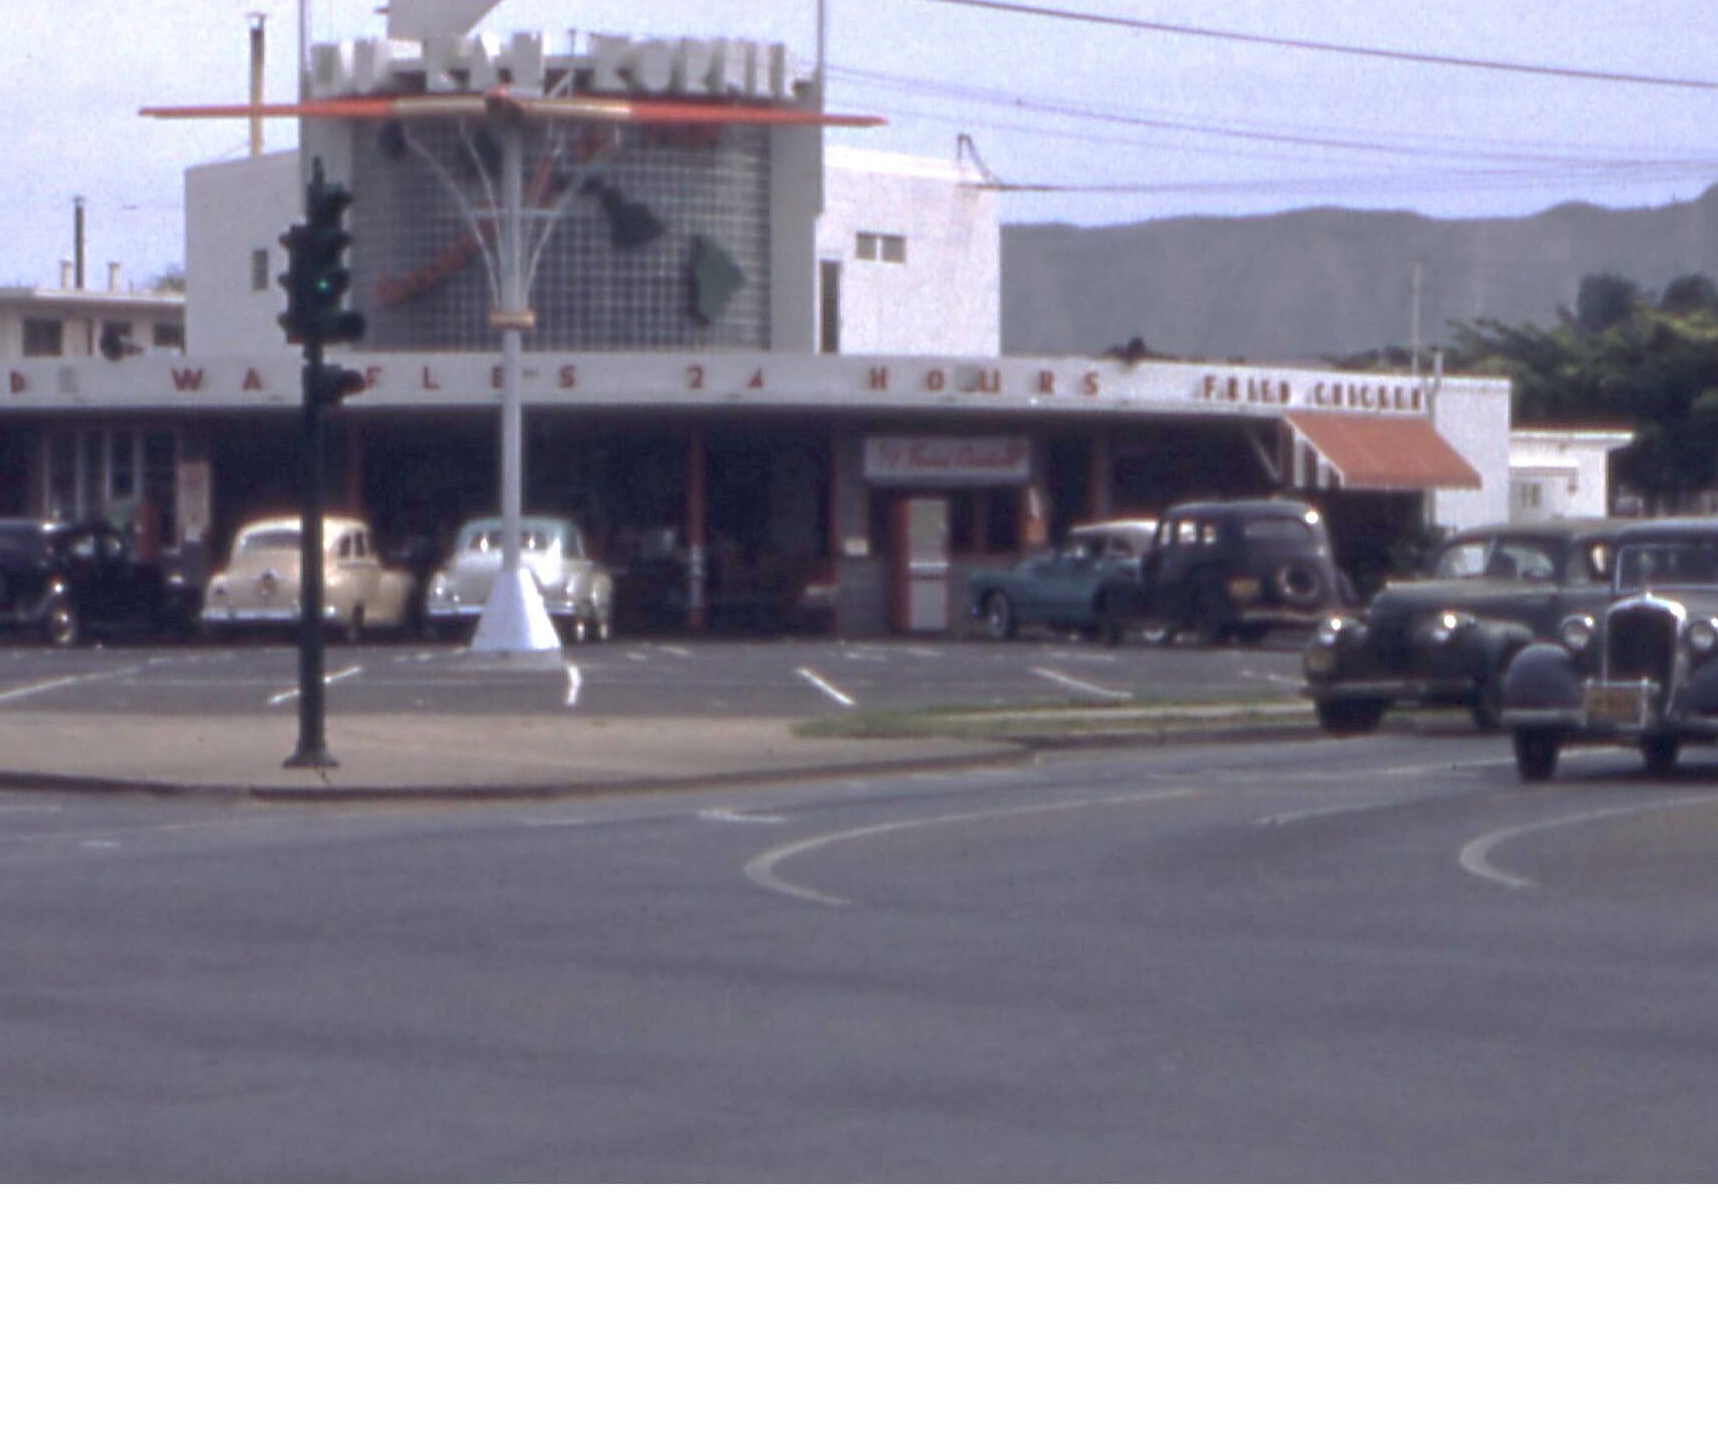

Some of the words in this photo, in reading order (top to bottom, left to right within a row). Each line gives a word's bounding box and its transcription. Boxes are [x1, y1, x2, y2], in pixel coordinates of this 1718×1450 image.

[172, 365, 576, 392] WAFLES
[687, 366, 764, 390] 24
[868, 367, 1099, 396] HOURS
